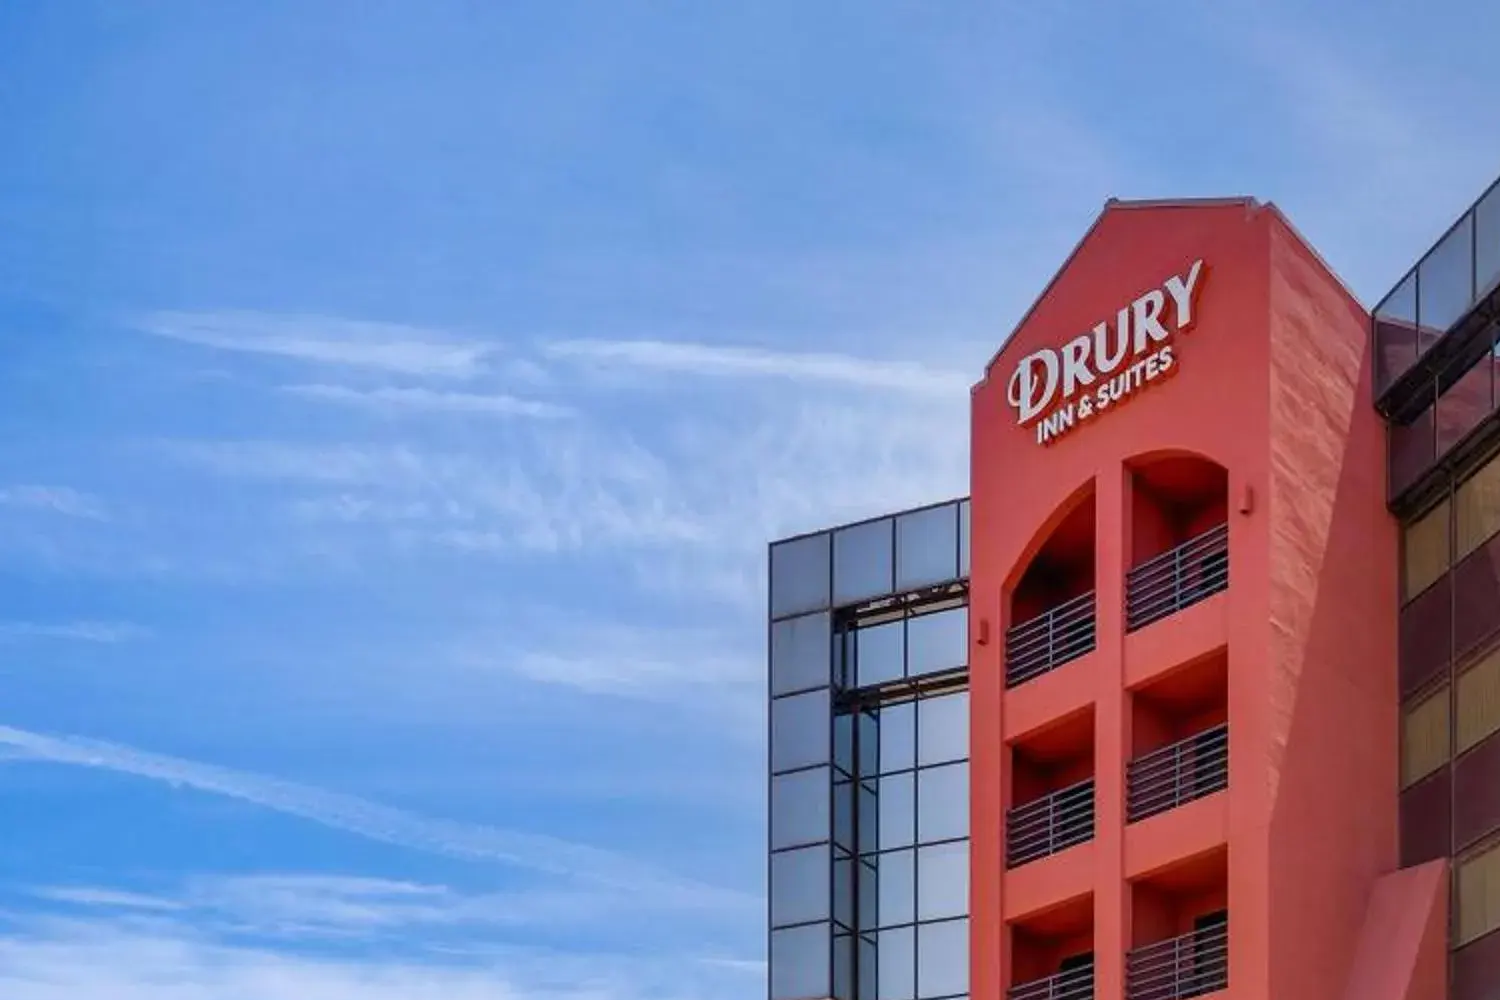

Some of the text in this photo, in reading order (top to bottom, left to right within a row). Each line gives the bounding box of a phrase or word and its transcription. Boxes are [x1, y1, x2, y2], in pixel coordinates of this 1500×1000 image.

[1007, 259, 1203, 424] DRURY
[1036, 345, 1174, 445] INN & SUITES
